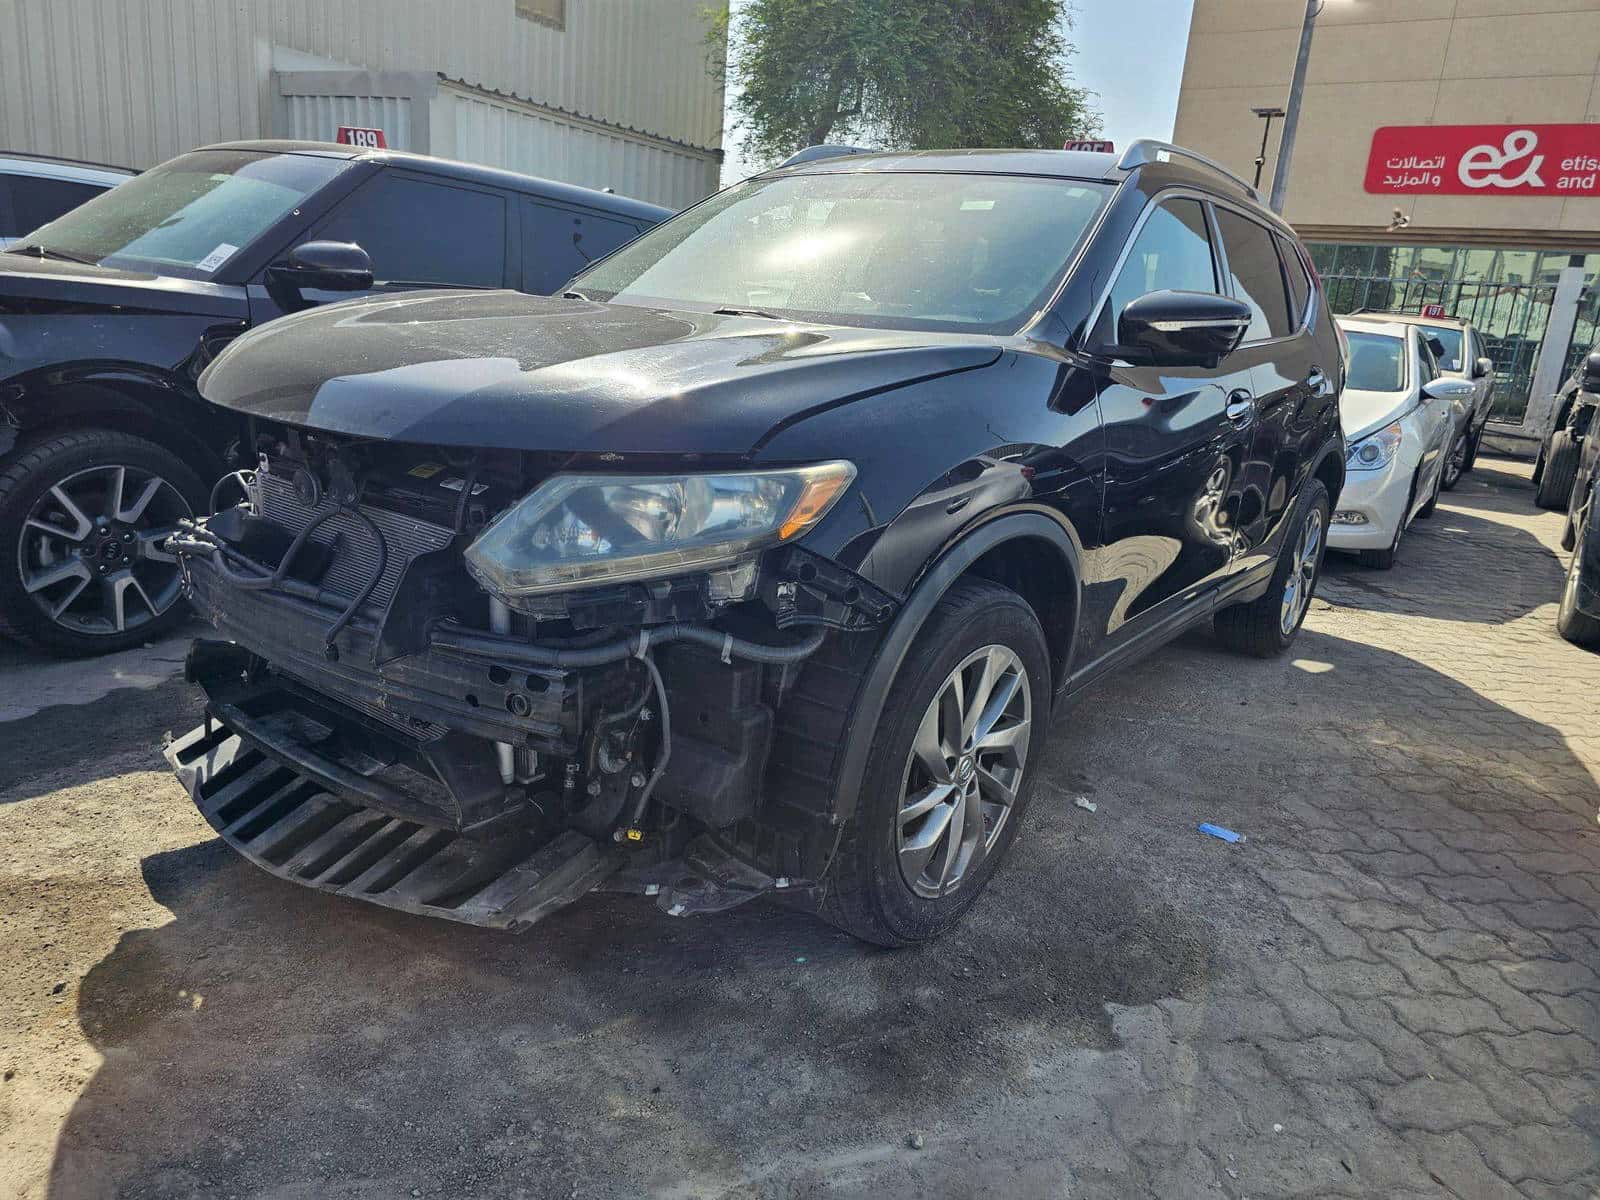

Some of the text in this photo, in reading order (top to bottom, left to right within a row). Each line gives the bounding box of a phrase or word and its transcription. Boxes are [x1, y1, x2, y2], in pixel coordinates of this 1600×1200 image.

[347, 130, 378, 148] 189
[1386, 155, 1445, 169] اتصالات
[1458, 130, 1546, 188] e&
[1561, 155, 1600, 171] etis
[1556, 174, 1596, 189] and
